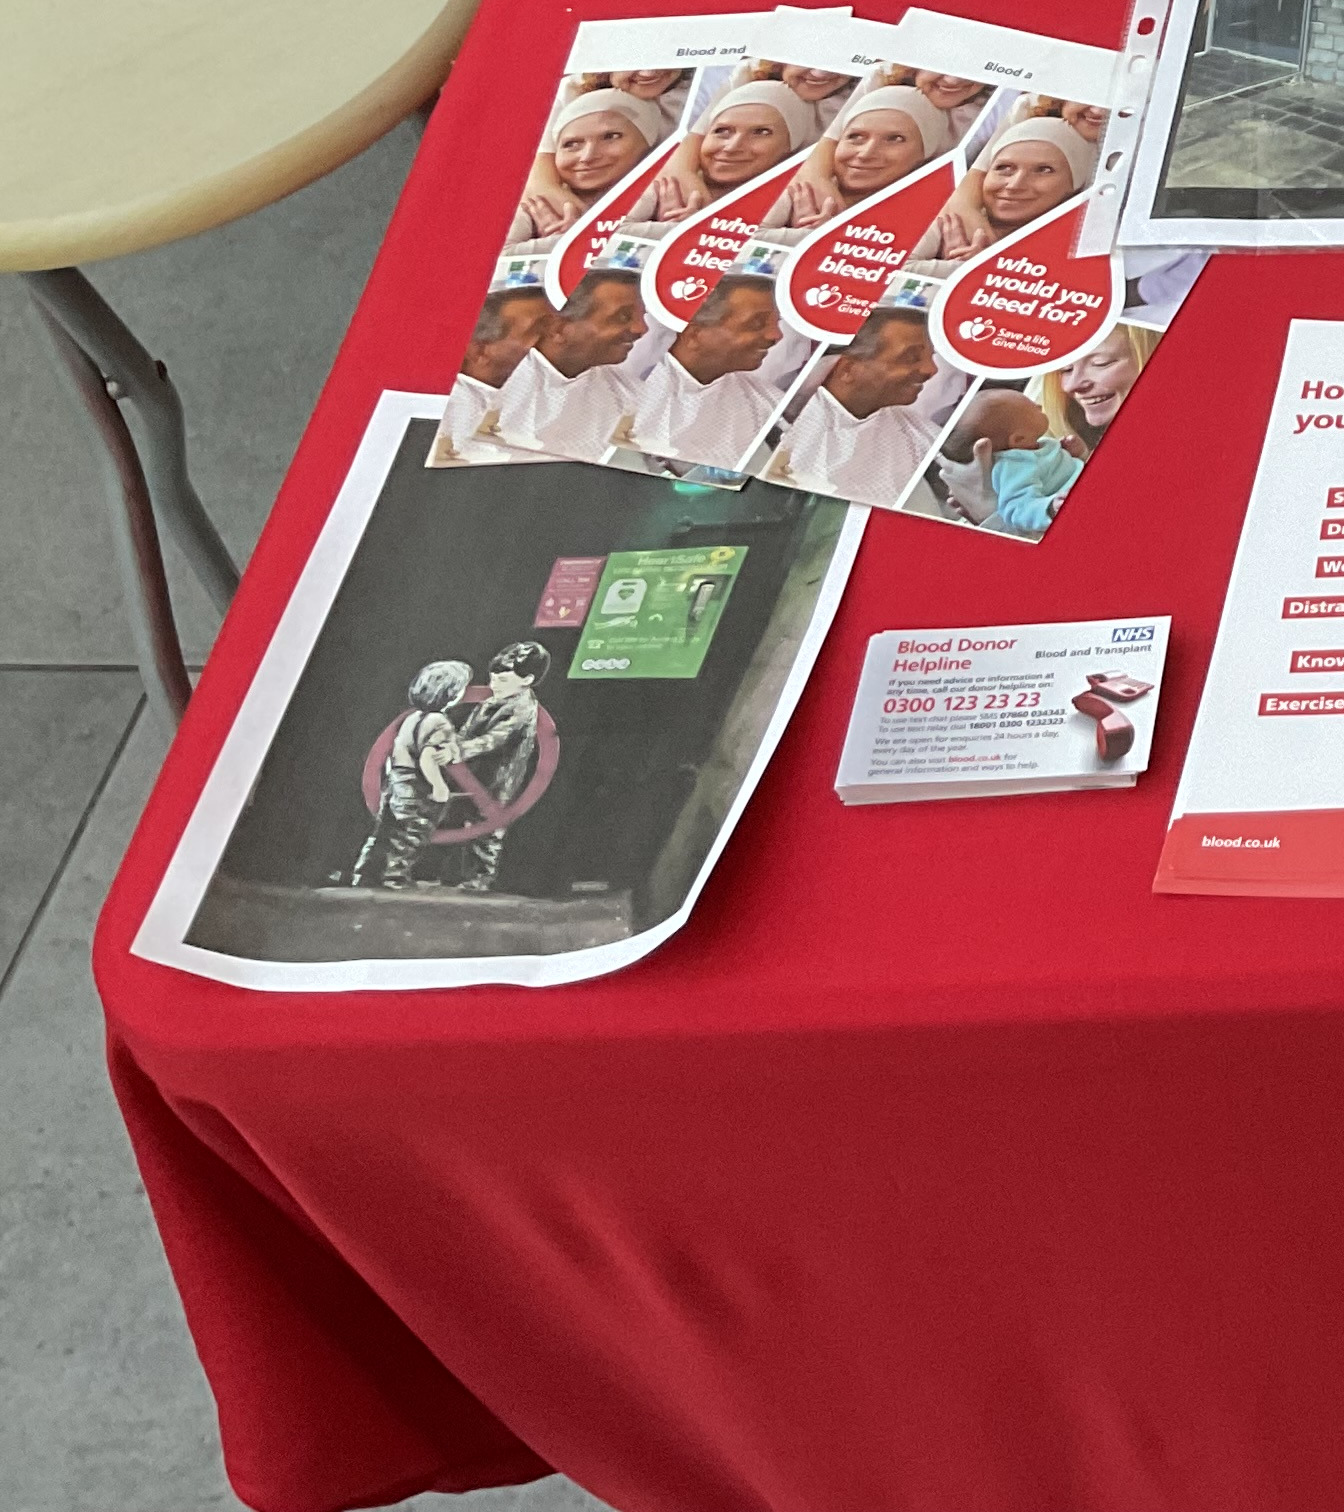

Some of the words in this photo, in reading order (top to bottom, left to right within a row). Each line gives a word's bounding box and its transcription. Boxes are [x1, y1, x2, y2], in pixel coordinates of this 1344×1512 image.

[996, 257, 1046, 276] who
[985, 274, 1059, 298] would
[1054, 289, 1103, 308] you
[971, 289, 1038, 316] bleed
[1038, 303, 1087, 326] for?
[898, 638, 952, 653] Blood
[957, 638, 1017, 651] Donor
[892, 656, 971, 674] Helpline
[883, 695, 935, 713] 0300
[943, 695, 977, 710] 123
[983, 693, 1009, 709] 23
[1015, 691, 1040, 707] 23
[1262, 696, 1344, 710] Exercise
[1201, 835, 1280, 848] blood.co.uk
